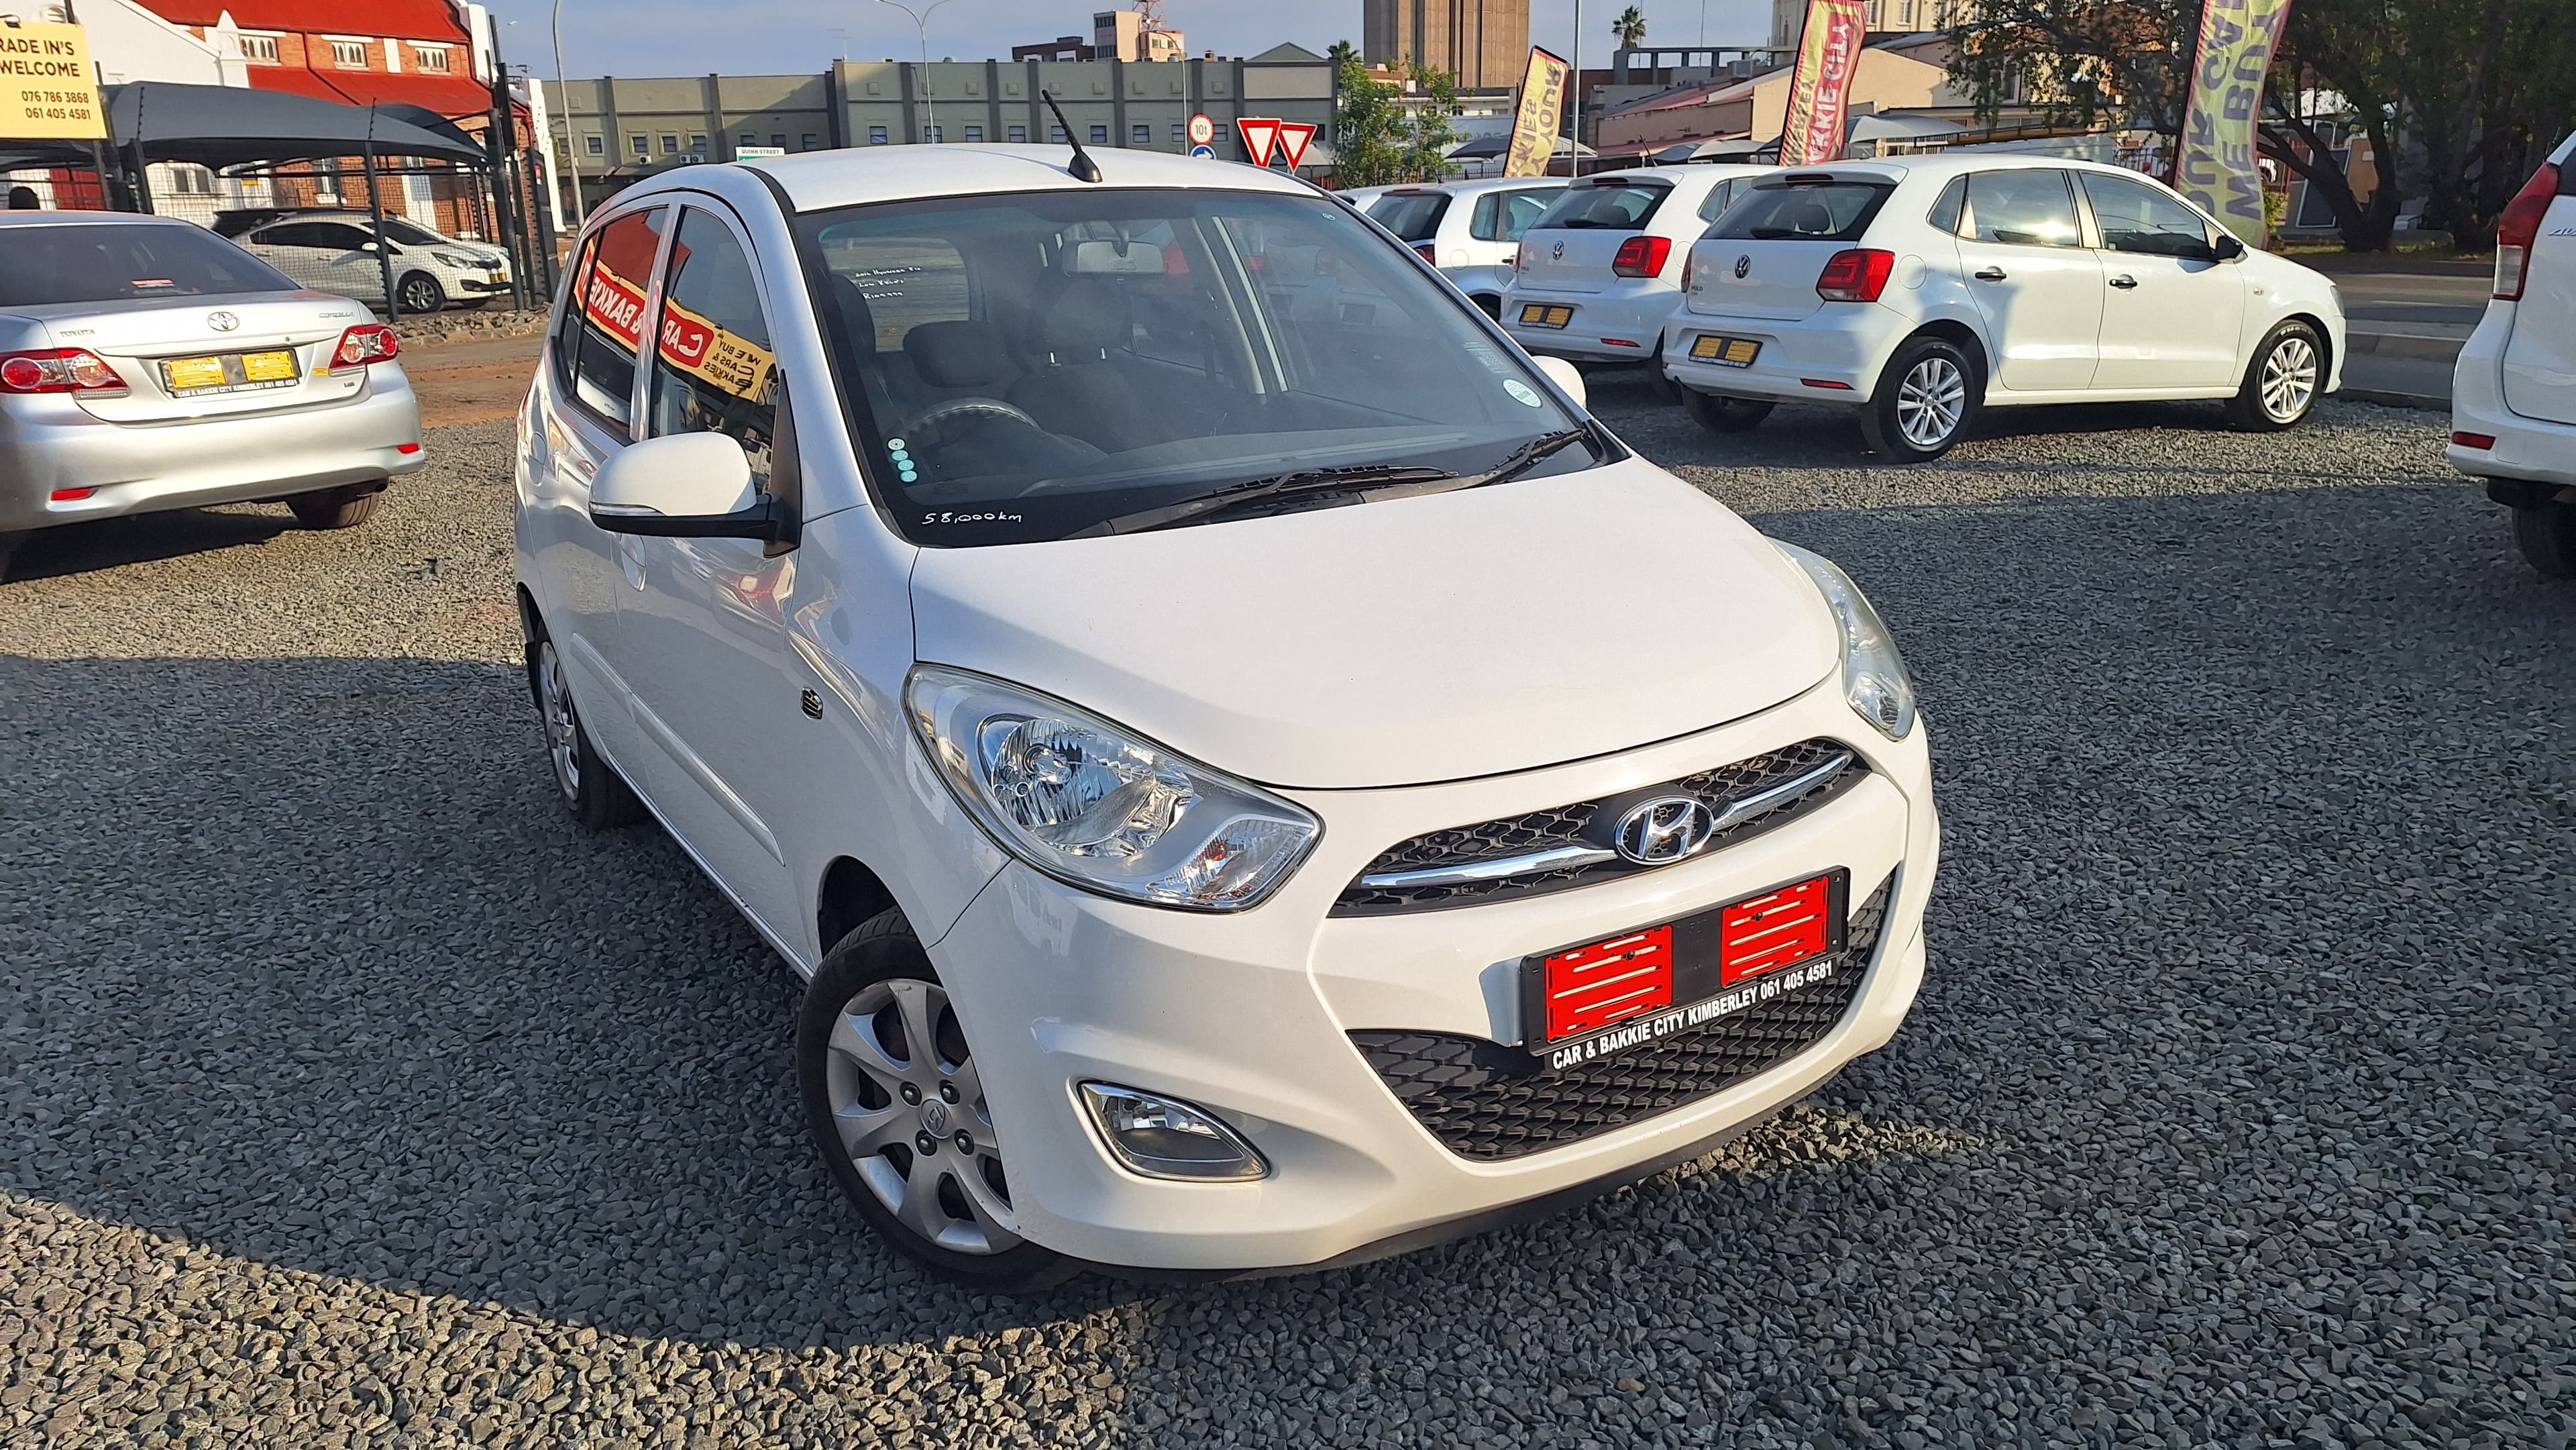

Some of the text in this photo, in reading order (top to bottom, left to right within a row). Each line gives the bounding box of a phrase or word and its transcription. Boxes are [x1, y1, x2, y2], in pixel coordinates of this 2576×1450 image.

[0, 38, 74, 56] RADE IN'S
[0, 60, 80, 77] WELCOME
[21, 90, 89, 103] 076 786 3868
[25, 107, 91, 120] 061 405 4581
[1195, 124, 1208, 136] 10t
[1553, 960, 1832, 1070] CAR & BAKKIE CITY KIMBERLEY 061 405 4581
